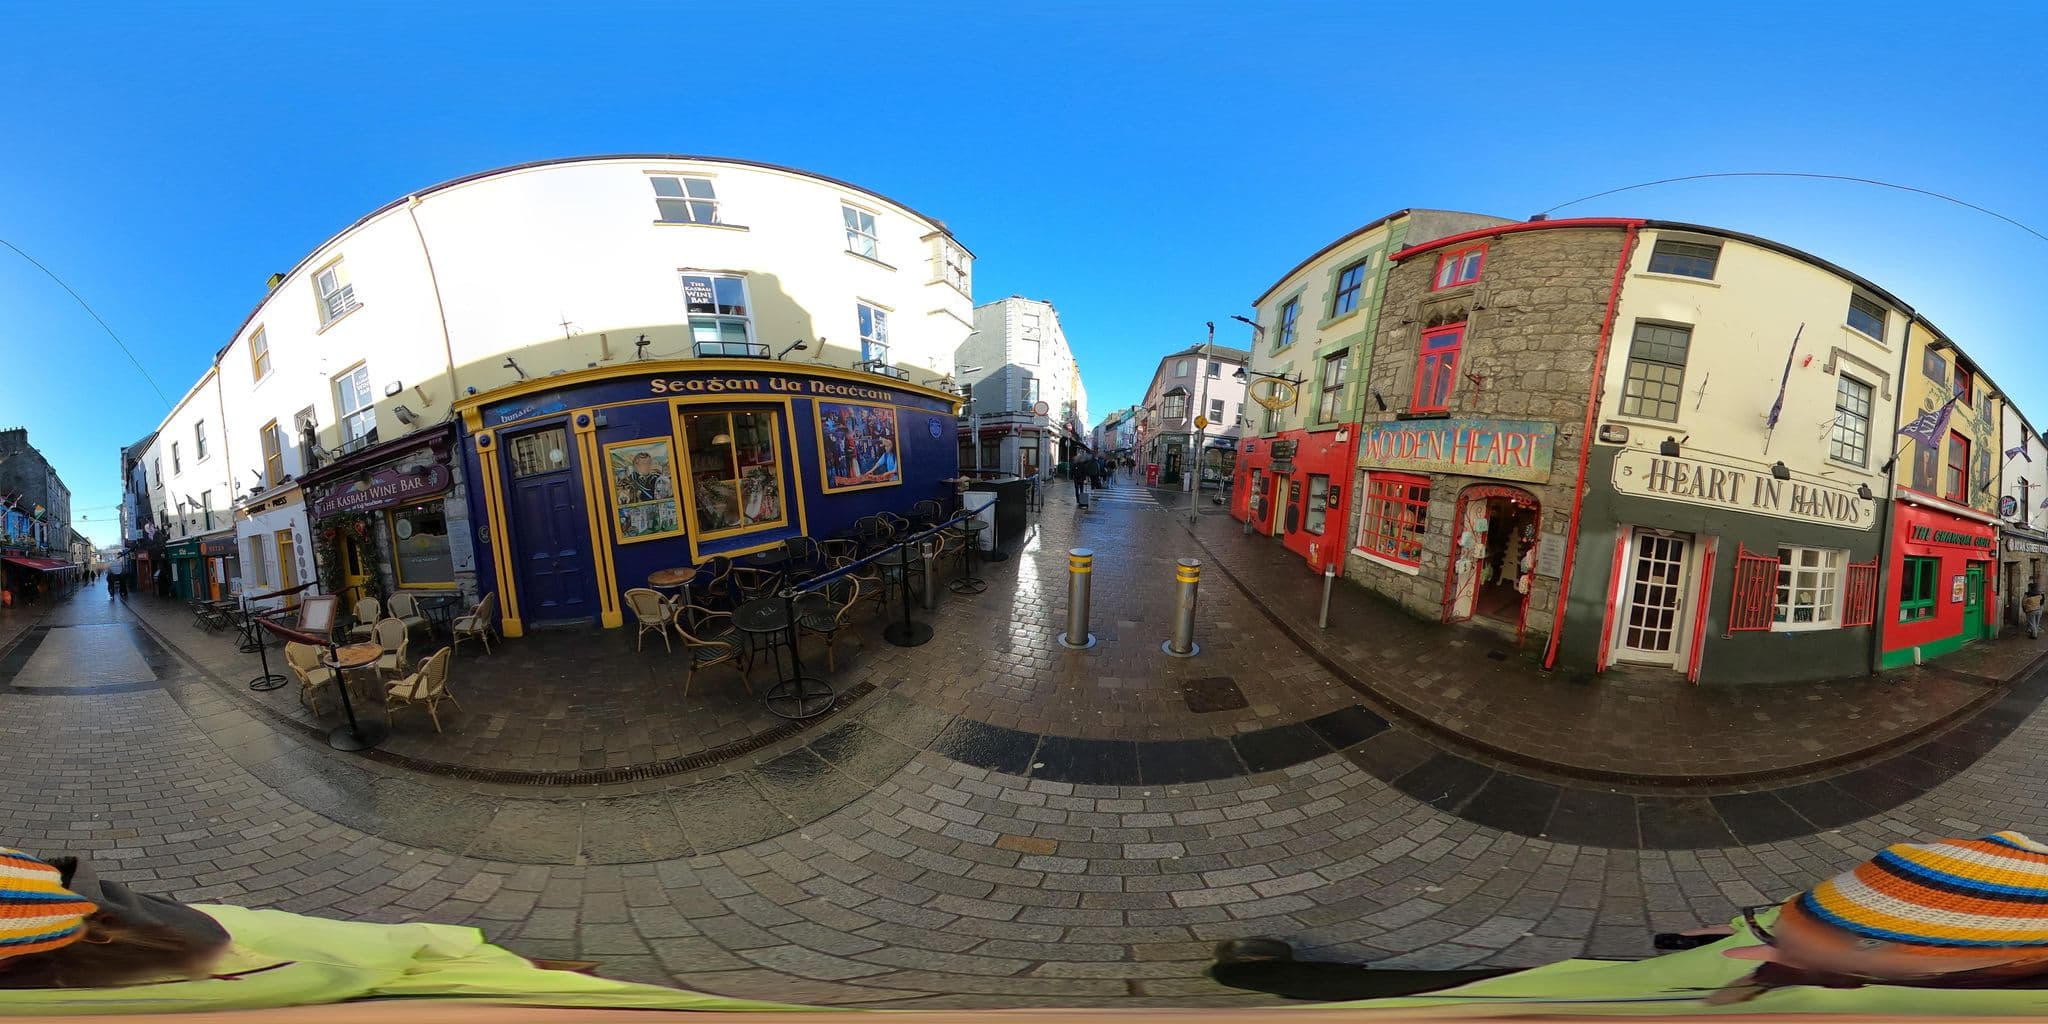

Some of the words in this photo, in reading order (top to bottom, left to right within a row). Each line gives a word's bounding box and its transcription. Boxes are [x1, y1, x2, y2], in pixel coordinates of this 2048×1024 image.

[1365, 429, 1446, 461] WOODEN
[1450, 427, 1545, 468] HEART
[322, 501, 336, 512] THE
[337, 491, 368, 508] KASBAH
[370, 483, 398, 499] WINE
[400, 477, 424, 492] BAR
[1643, 457, 1746, 505] HEART
[1752, 475, 1783, 511] IN
[1790, 482, 1860, 524] HANDS
[1912, 525, 1932, 541] THE
